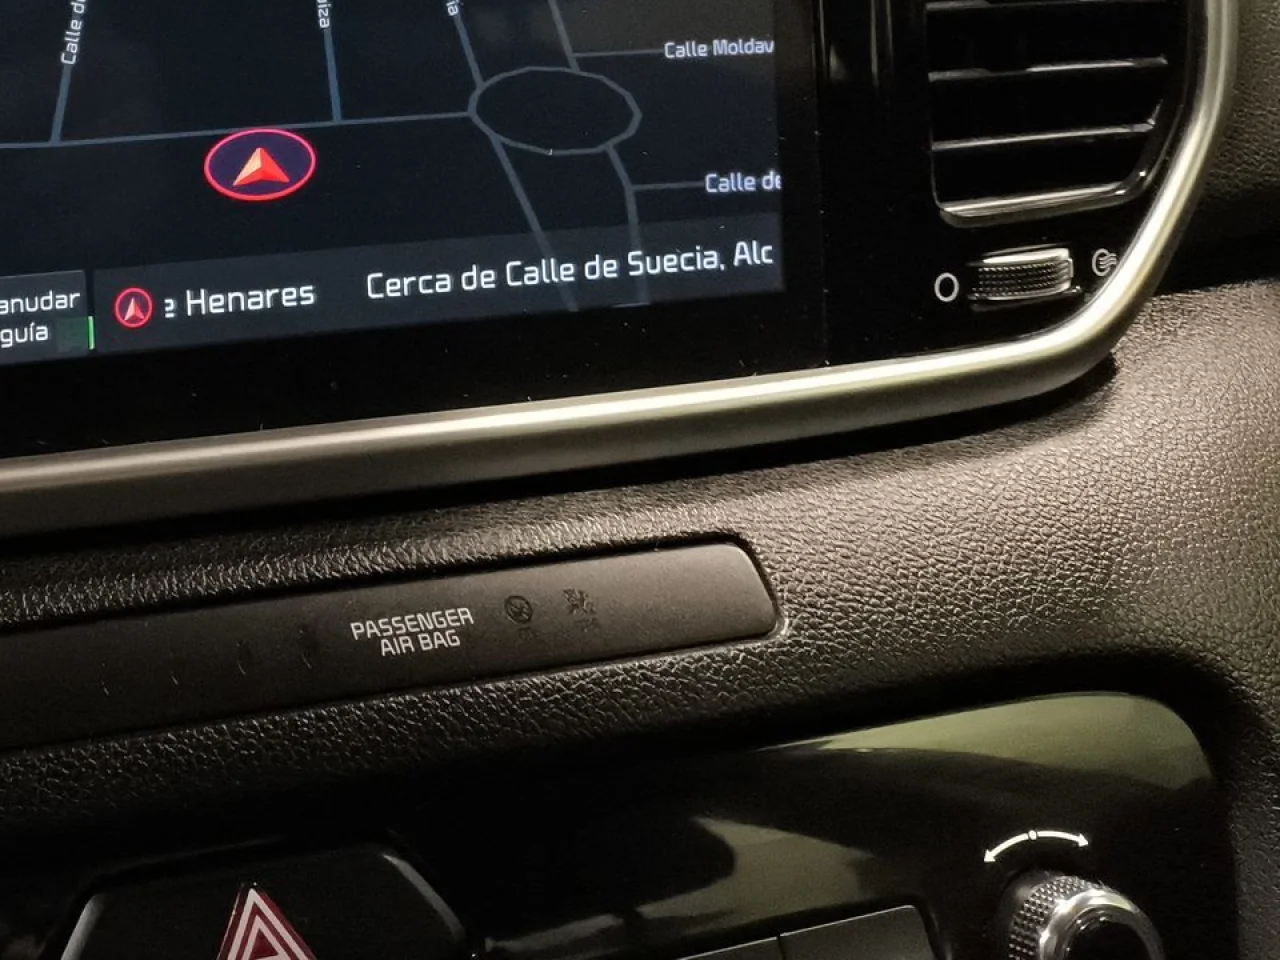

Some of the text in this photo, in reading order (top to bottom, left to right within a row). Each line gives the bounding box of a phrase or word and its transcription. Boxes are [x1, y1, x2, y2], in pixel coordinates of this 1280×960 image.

[60, 18, 84, 65] Calle
[664, 37, 775, 59] Calle Moldav
[705, 171, 757, 193] Calle
[186, 284, 315, 317] Henares
[367, 272, 452, 299] Cerca
[460, 264, 496, 291] de
[505, 257, 576, 287] Calle
[584, 254, 618, 280] de
[627, 245, 726, 277] Suecia,
[733, 240, 774, 267] Alc
[0, 321, 49, 349] guía
[350, 606, 474, 641] PASSENGER
[380, 629, 461, 657] AIR BAG
